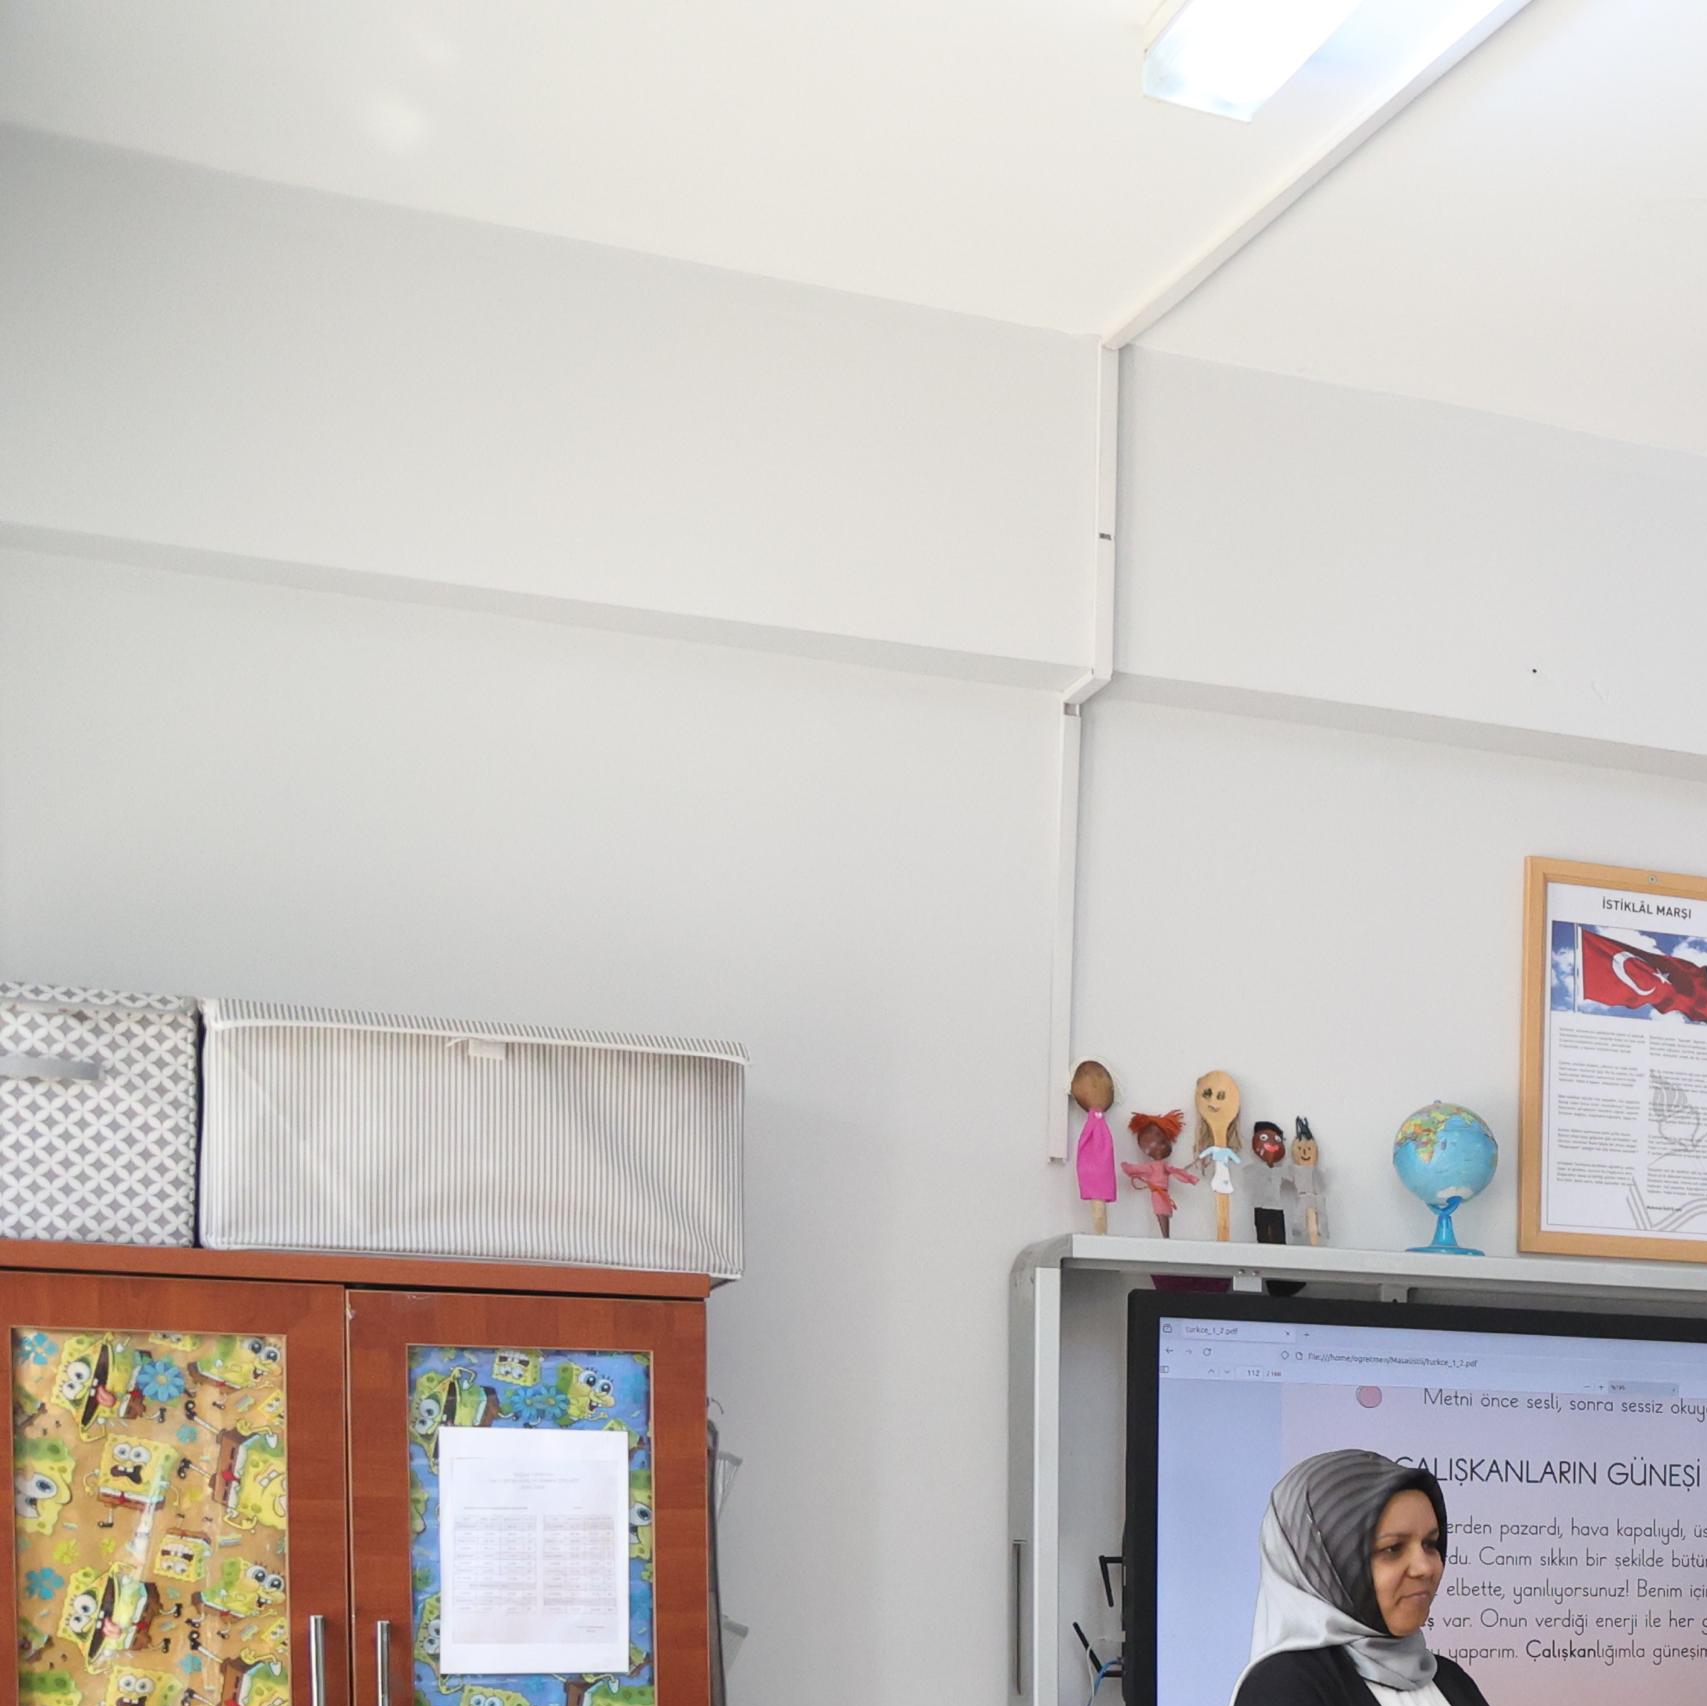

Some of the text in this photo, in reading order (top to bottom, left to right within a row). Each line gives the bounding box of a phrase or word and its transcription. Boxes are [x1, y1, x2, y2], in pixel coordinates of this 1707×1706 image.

[1602, 896, 1692, 920] İSTİKLÂL MARŞI
[1424, 1388, 1473, 1407] Metni
[1481, 1391, 1519, 1408] önce
[1526, 1393, 1562, 1412] sesli,
[1570, 1398, 1613, 1412] sonra
[1621, 1398, 1663, 1414] sessiz
[1396, 1456, 1597, 1486] ALIŞKANLARIN
[1607, 1456, 1701, 1491] GÜNEŞİ
[1446, 1515, 1492, 1534] erden
[1500, 1517, 1563, 1542] pazardı,
[1571, 1518, 1609, 1537] hava
[1617, 1518, 1686, 1545] kapalıydı,
[1479, 1546, 1532, 1566] Canım
[1540, 1547, 1578, 1567] sıkkın
[1586, 1548, 1607, 1567] bir
[1615, 1548, 1664, 1570] şekilde
[1446, 1577, 1505, 1600] elbette,
[1513, 1578, 1629, 1604] yanılıyorsunuz!
[1637, 1578, 1683, 1598] Benim
[1443, 1616, 1472, 1628] var.
[1480, 1608, 1527, 1628] Onun
[1535, 1609, 1588, 1636] verdiği
[1595, 1615, 1638, 1635] enerji
[1645, 1609, 1661, 1628] ile
[1669, 1609, 1695, 1628] her
[1448, 1648, 1518, 1666] yaparım.
[1526, 1639, 1645, 1666] Çalışkanlığımla
